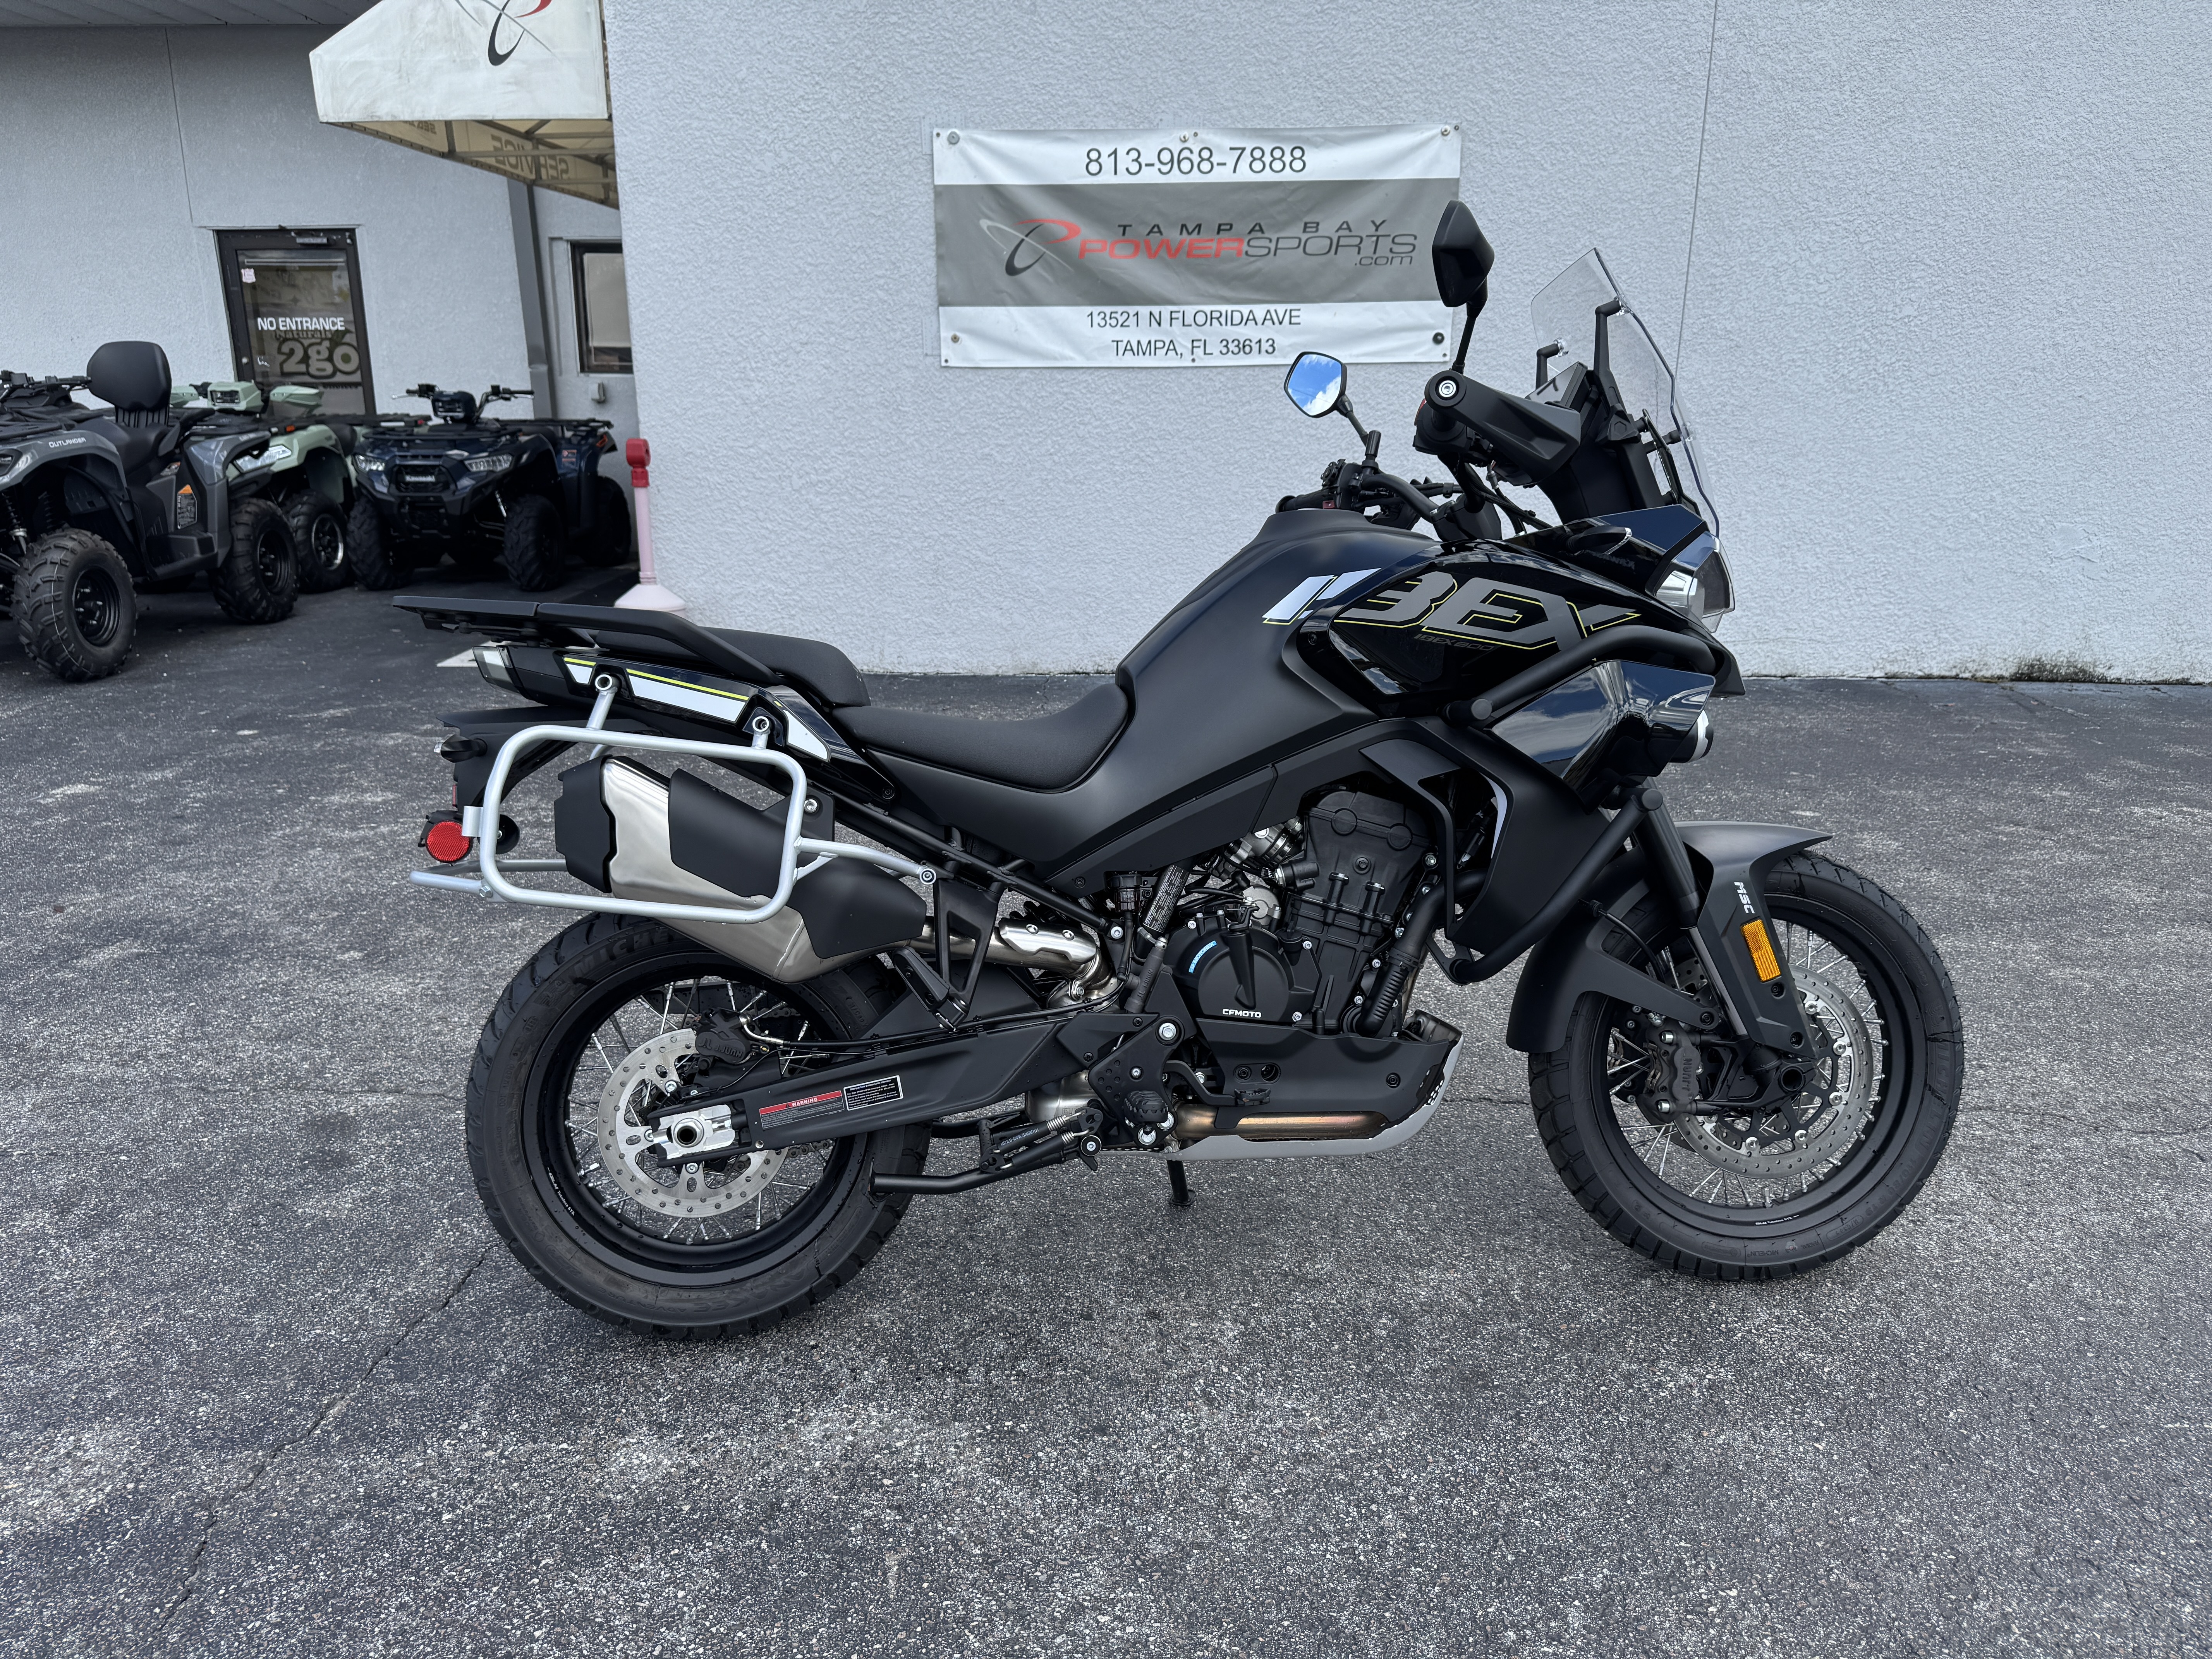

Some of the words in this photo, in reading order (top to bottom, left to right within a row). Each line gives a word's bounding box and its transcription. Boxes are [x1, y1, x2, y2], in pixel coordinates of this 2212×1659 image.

[1085, 146, 1307, 176] 813-968-7888
[1118, 222, 1267, 235] TAMPA
[1303, 220, 1388, 232] BAY
[1079, 233, 1417, 259] POWERSPORTS
[1354, 254, 1413, 266] .com
[257, 317, 276, 330] NO
[280, 317, 345, 330] ENTRANCE
[1086, 310, 1140, 330] 13521
[1149, 310, 1162, 327] N
[1169, 309, 1259, 327] FLORIDA
[1261, 309, 1302, 326] AVE
[1112, 338, 1184, 359] TAMPA,
[1190, 338, 1212, 356] FL
[1219, 338, 1276, 356] 33613
[277, 338, 360, 380] 2go
[49, 437, 86, 448] OUTLANDER
[1734, 881, 1755, 914] MSC
[1223, 1009, 1261, 1018] CFMOTO
[715, 1044, 743, 1058] J.JUAN
[791, 1097, 817, 1106] WARNING
